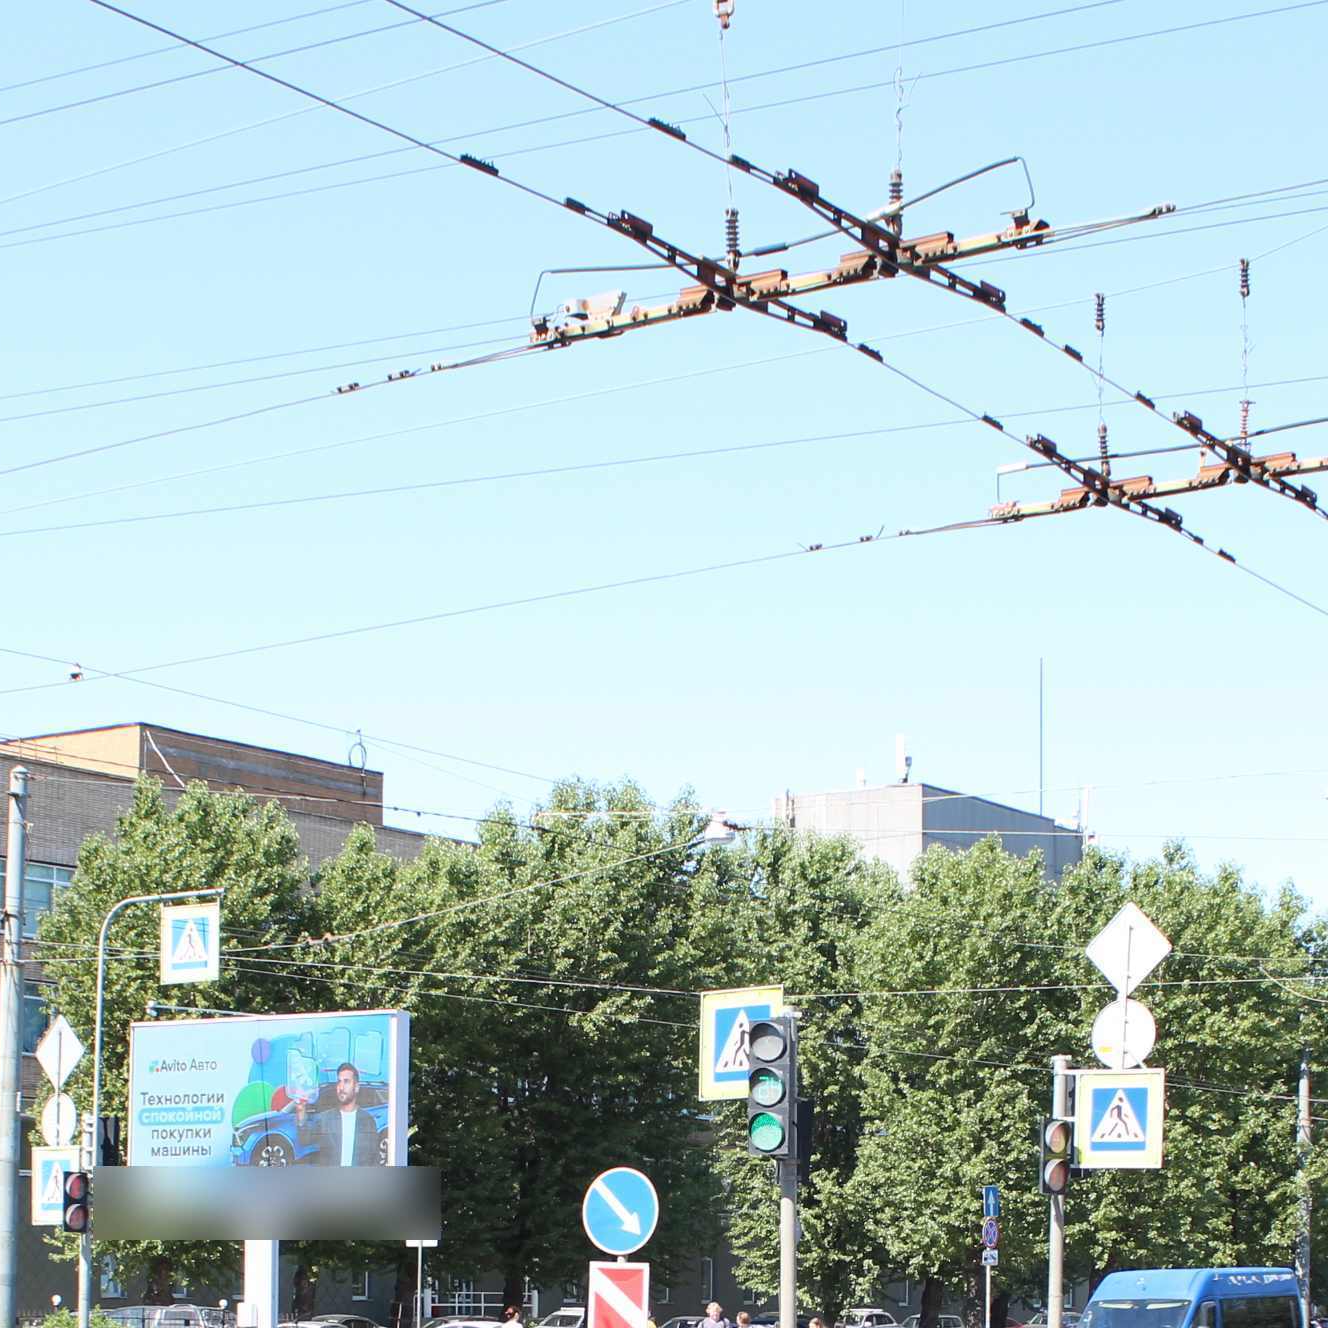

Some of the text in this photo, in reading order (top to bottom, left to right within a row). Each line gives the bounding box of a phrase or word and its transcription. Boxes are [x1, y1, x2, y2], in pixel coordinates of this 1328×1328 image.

[160, 1058, 217, 1072] Avito Авто
[140, 1091, 224, 1105] Технологии
[141, 1107, 222, 1122] спокойной
[151, 1127, 212, 1142] покупки
[151, 1145, 212, 1157] машины
